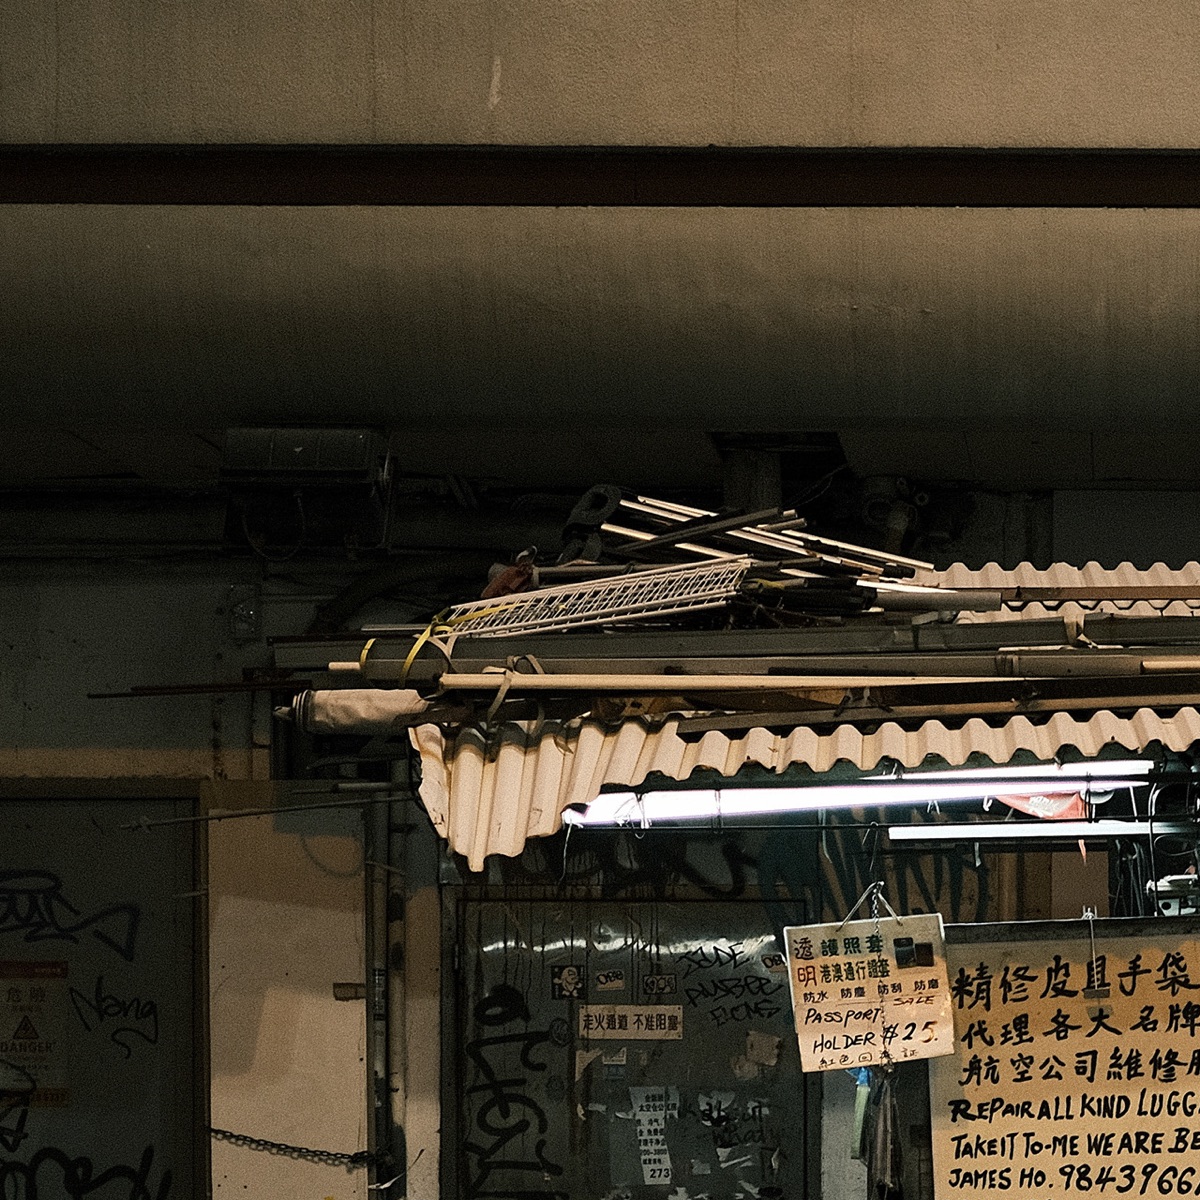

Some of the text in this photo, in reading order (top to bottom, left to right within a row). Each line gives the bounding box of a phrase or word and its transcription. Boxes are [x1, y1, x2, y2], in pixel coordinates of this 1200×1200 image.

[803, 990, 828, 1003] 防水
[582, 1013, 628, 1030] 走火通道
[804, 1008, 881, 1027] PASSPORT
[813, 1031, 876, 1053] HOLDER
[948, 1098, 1035, 1124] REPAIR
[1038, 1097, 1074, 1121] ALL
[1081, 1095, 1130, 1119] KIND
[650, 1168, 670, 1179] 273
[949, 1168, 1011, 1190] JAMES
